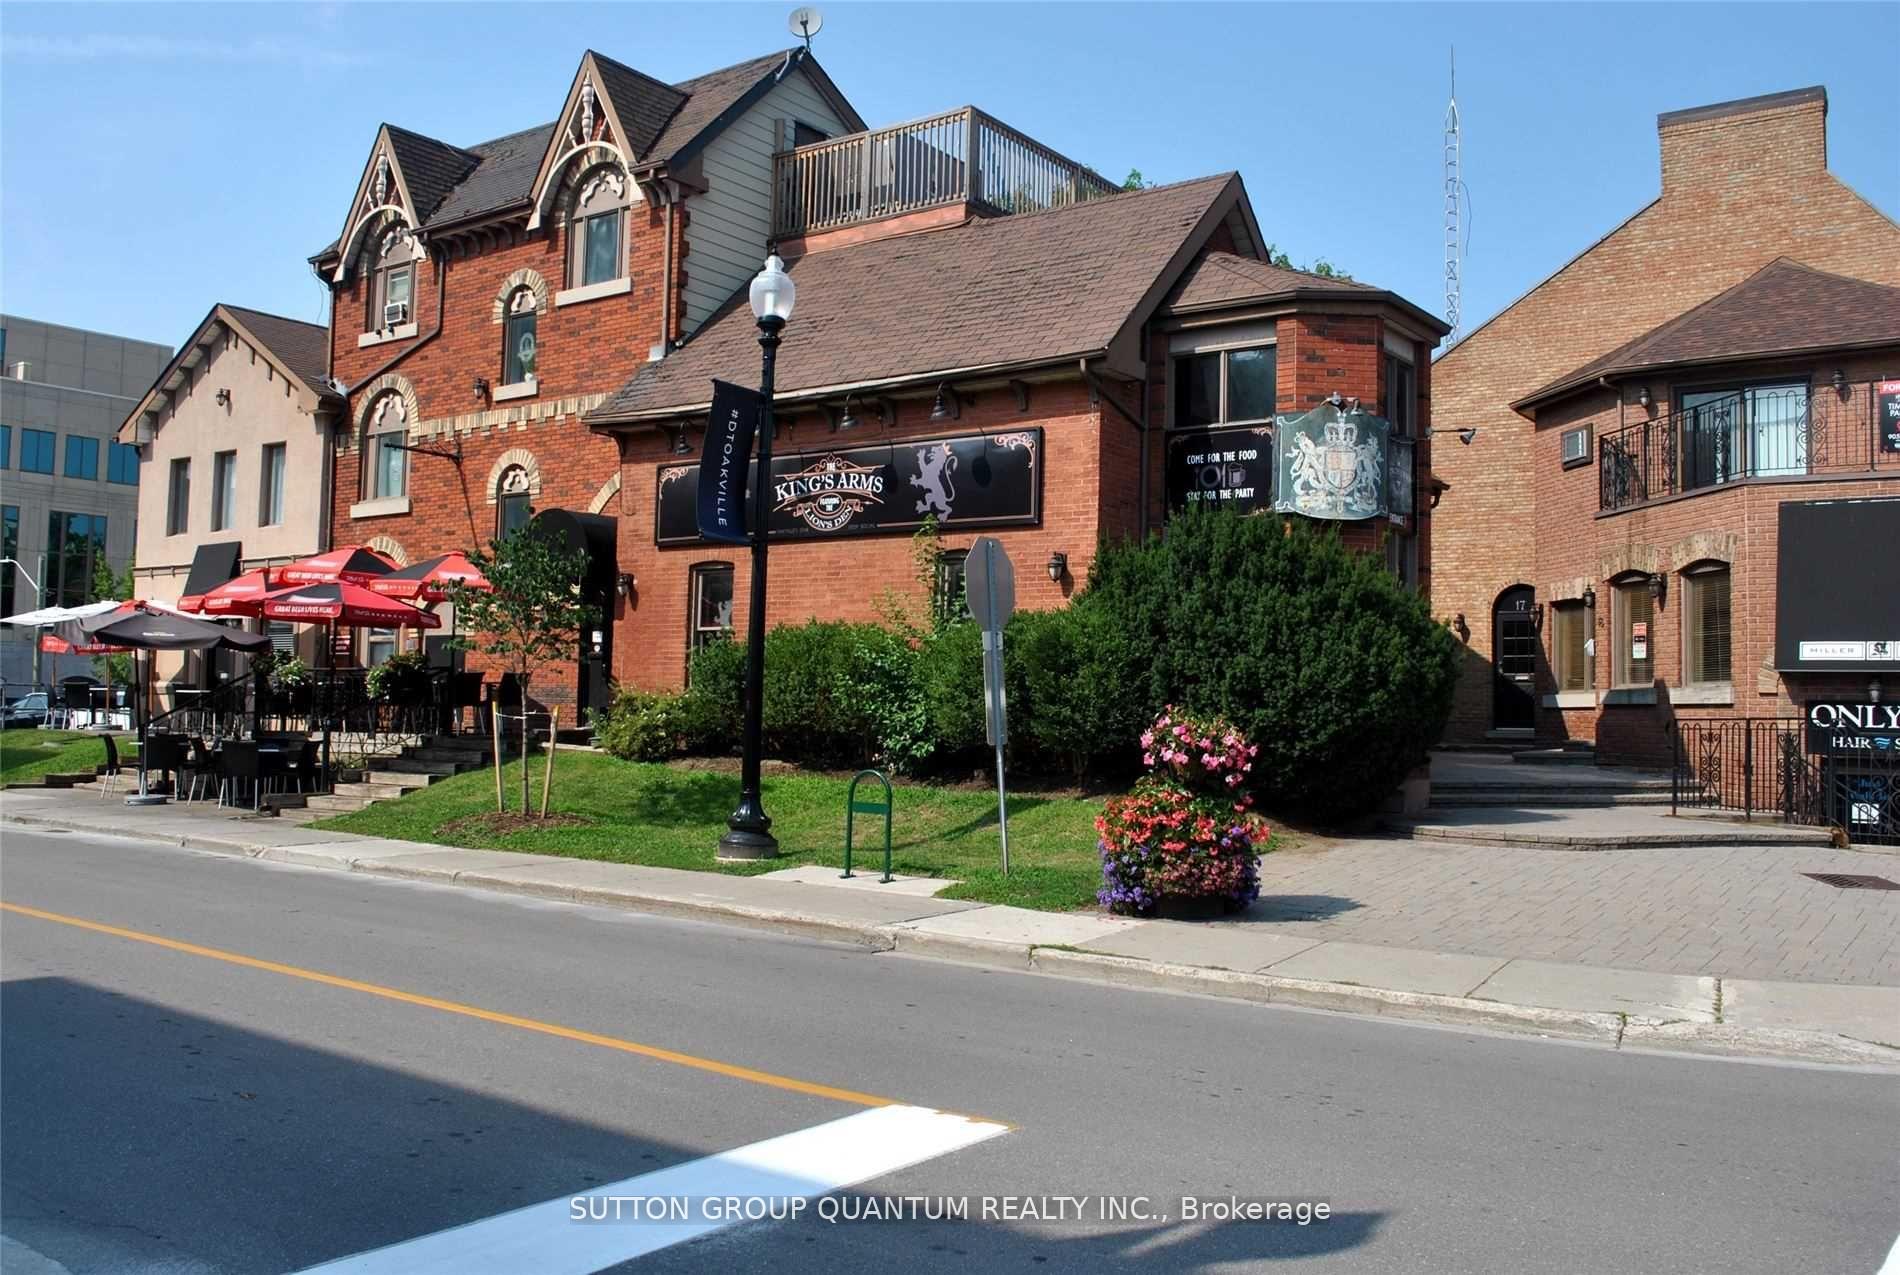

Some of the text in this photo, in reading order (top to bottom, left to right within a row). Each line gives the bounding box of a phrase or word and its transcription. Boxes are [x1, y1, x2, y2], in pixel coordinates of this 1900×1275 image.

[1187, 449, 1257, 464] COME FOR THE FOOD
[717, 408, 739, 527] #DTOAKVILLE
[774, 472, 884, 502] KING'S ARMS
[1220, 489, 1232, 499] THE
[1235, 487, 1255, 498] PARTY
[804, 505, 853, 529] LION'S DEN
[1516, 600, 1525, 610] 17
[1811, 704, 1900, 728] ONLY
[1832, 736, 1872, 749] HAIR
